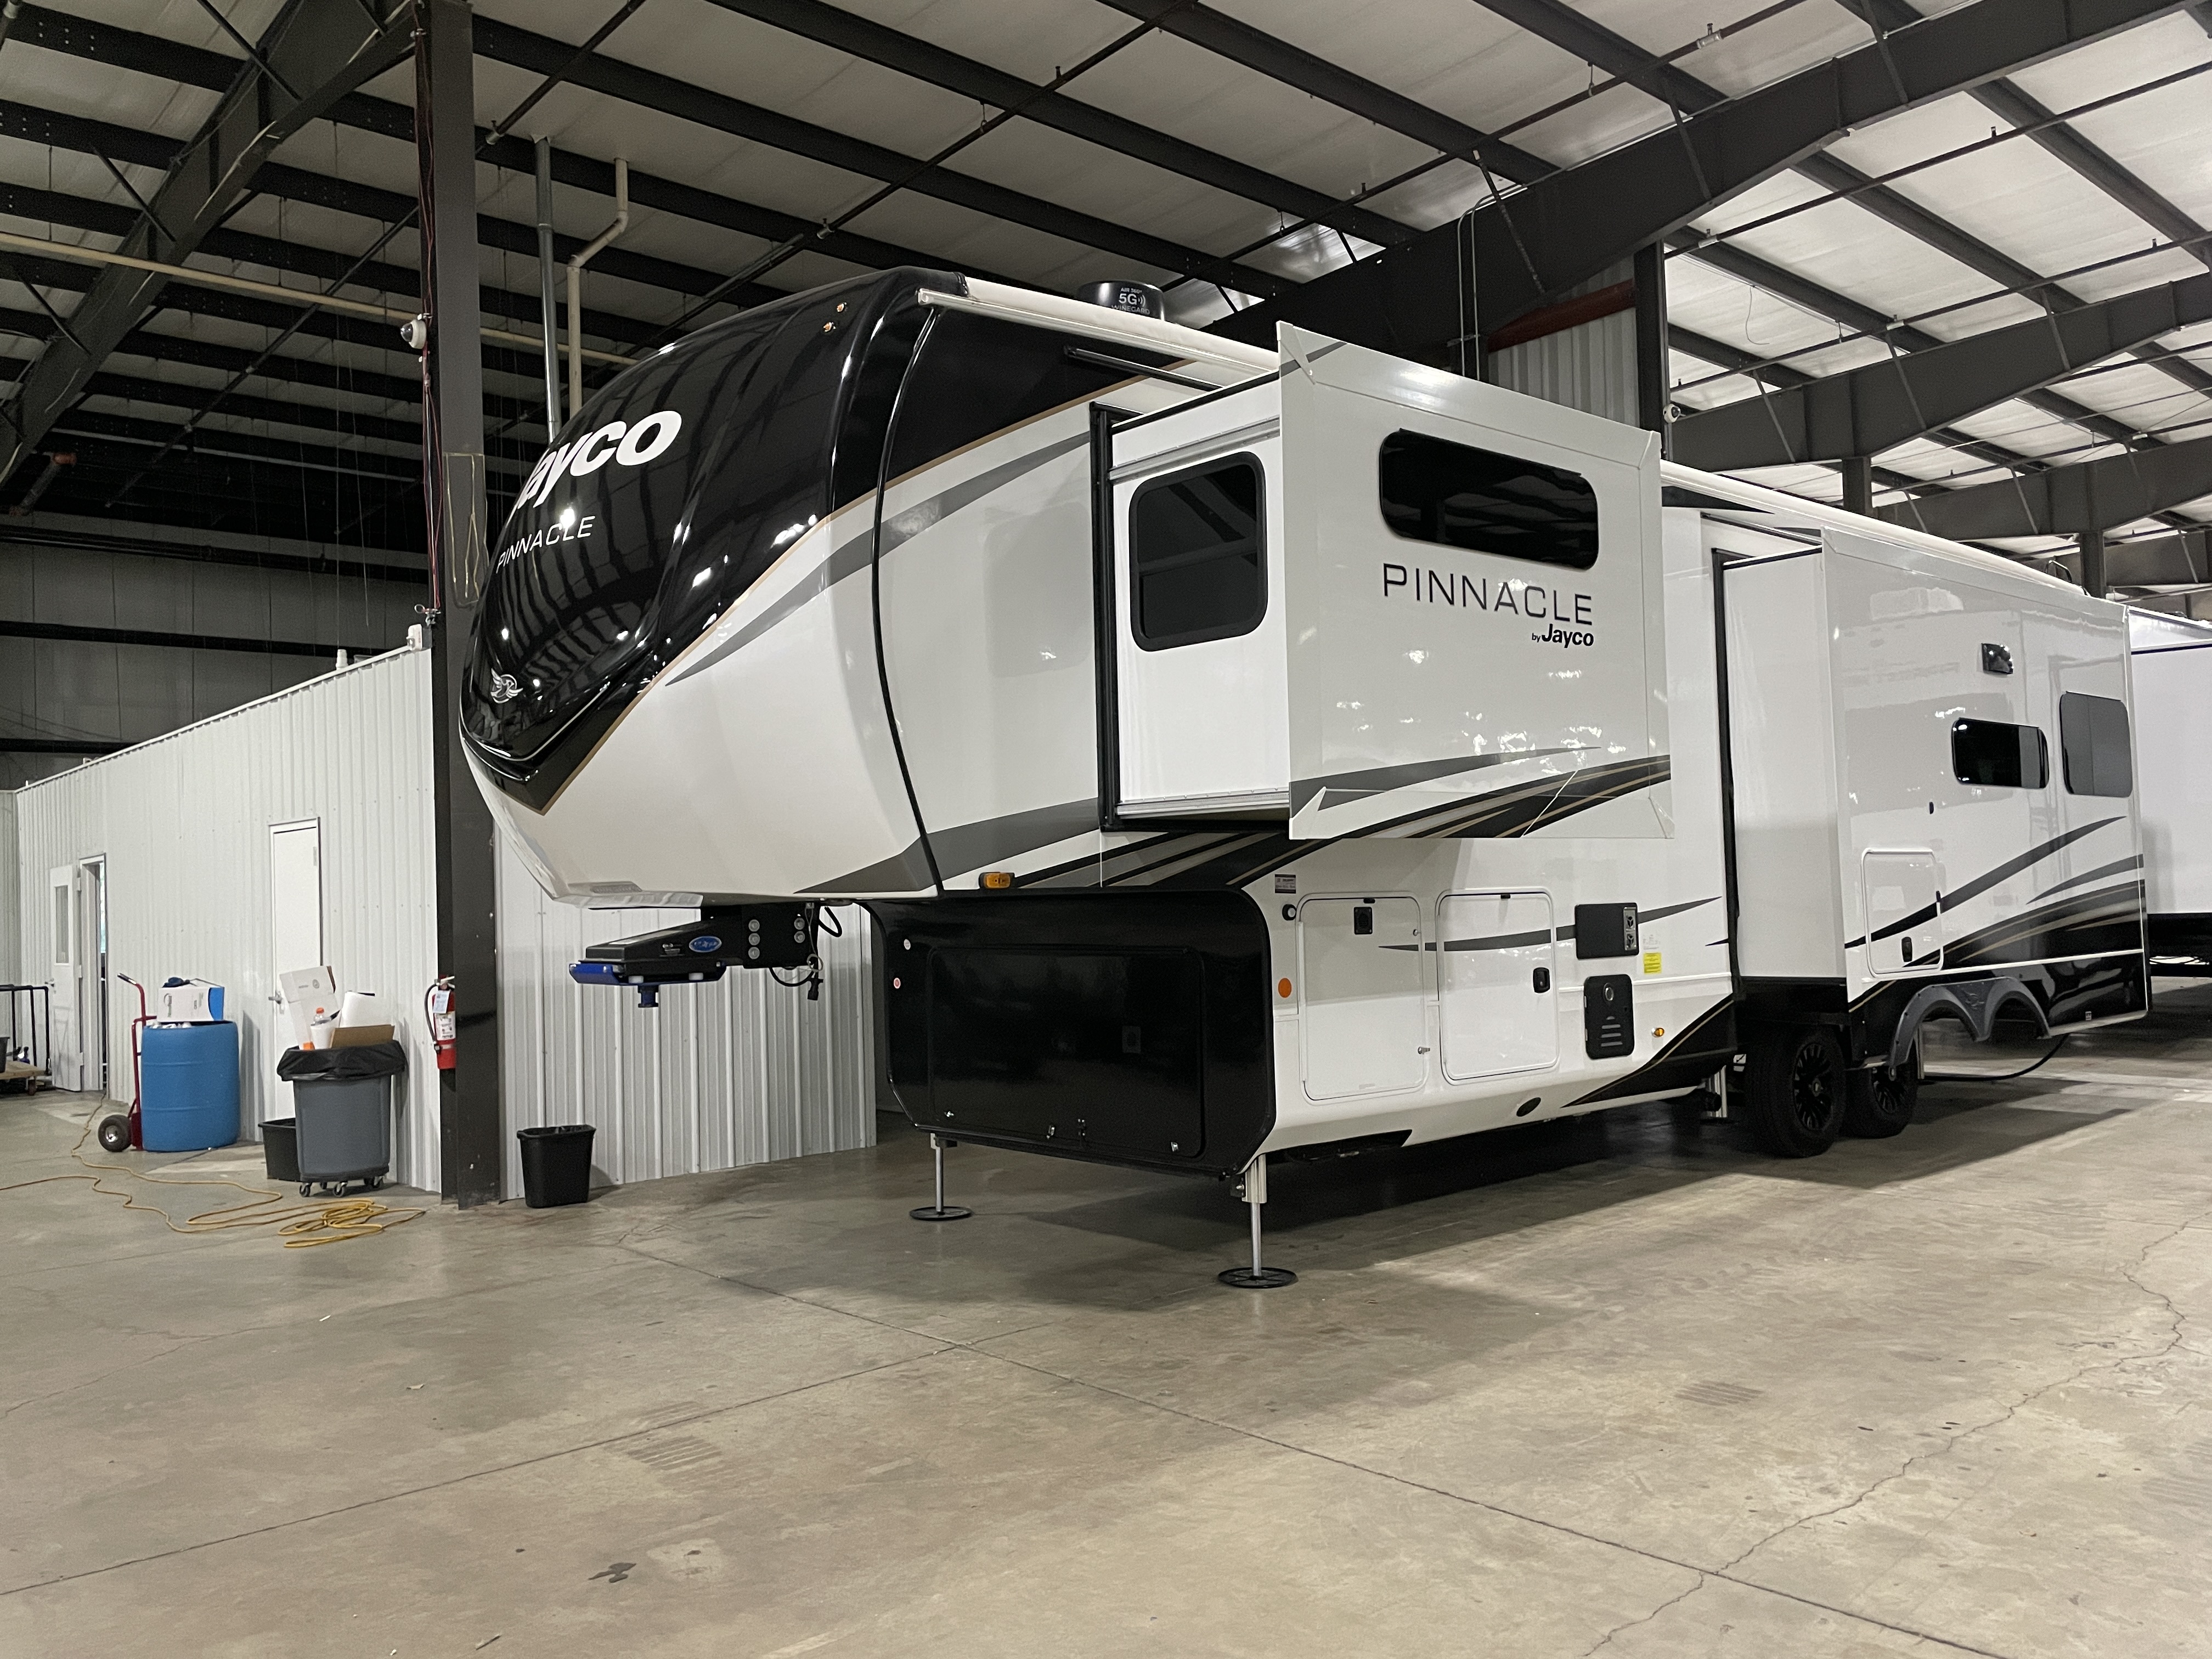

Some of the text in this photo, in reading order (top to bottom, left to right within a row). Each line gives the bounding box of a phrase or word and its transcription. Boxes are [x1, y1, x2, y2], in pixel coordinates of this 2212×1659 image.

[1119, 293, 1137, 305] 5G
[515, 411, 682, 511] ayco
[496, 516, 595, 574] PINNACLE
[1383, 563, 1592, 625] PINNACLE
[1532, 624, 1594, 648] by Jayco
